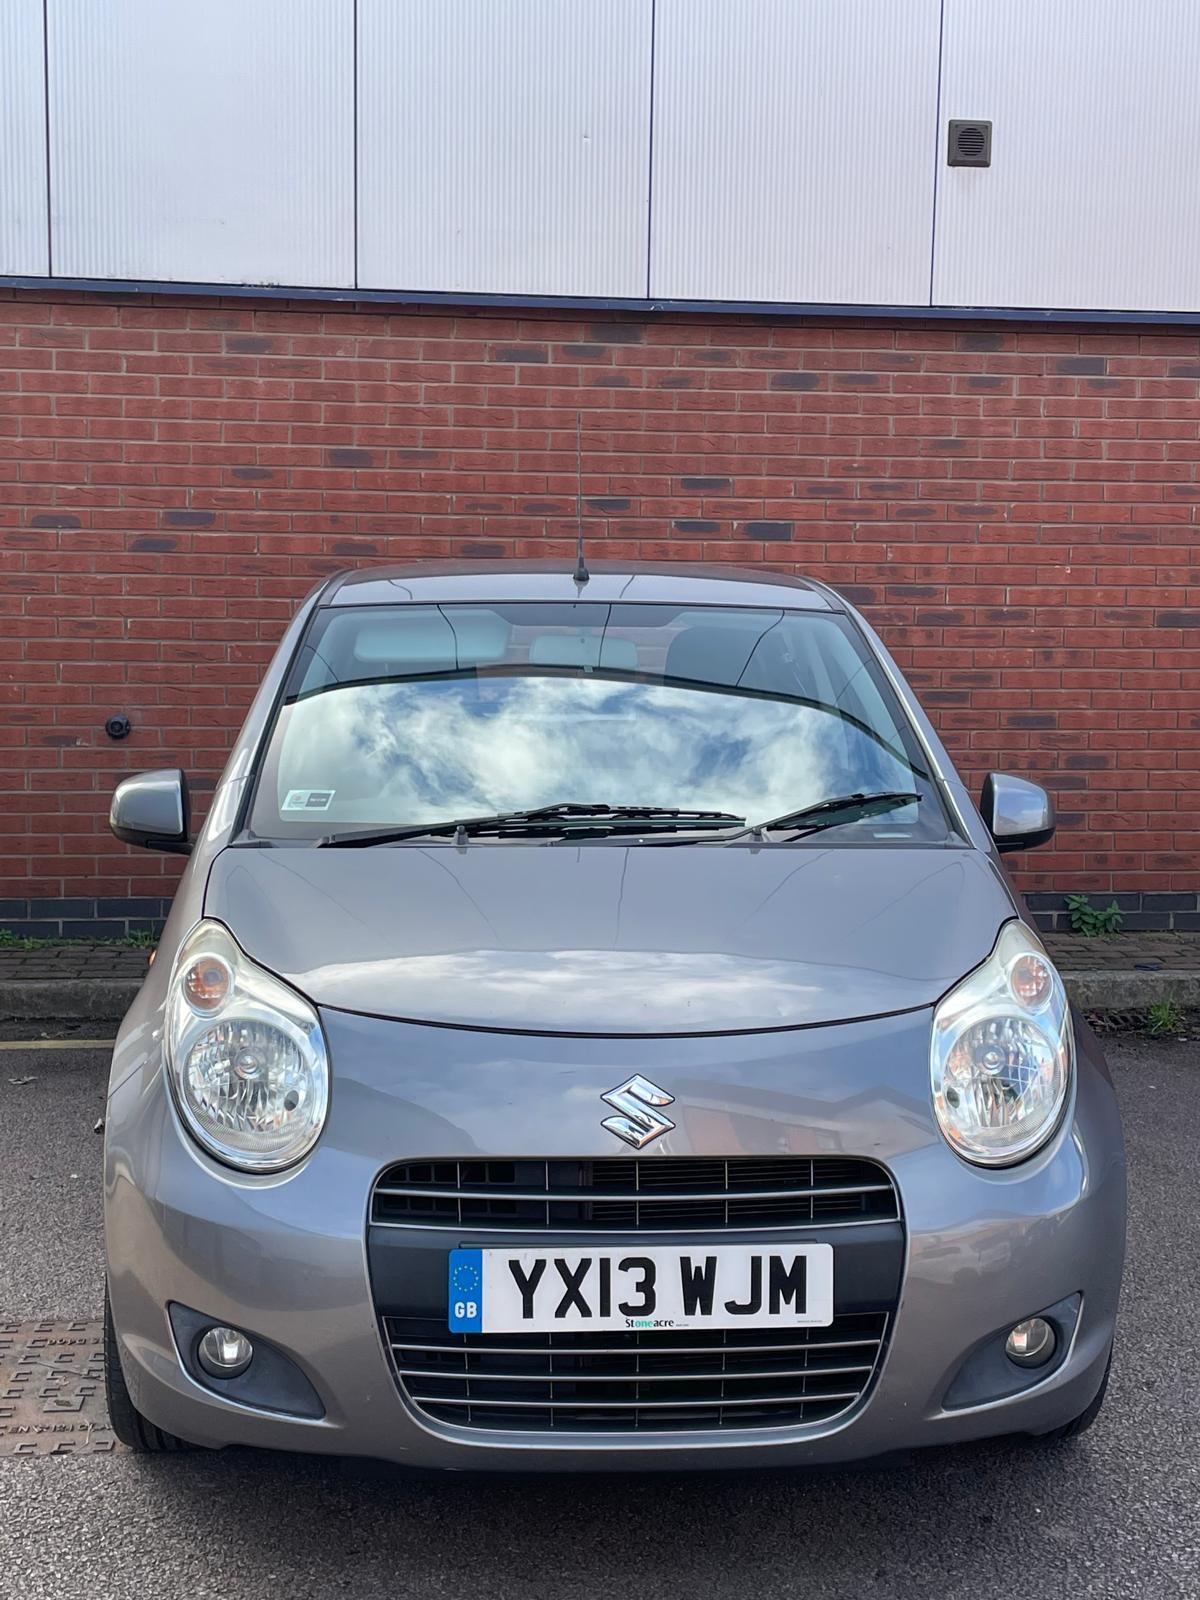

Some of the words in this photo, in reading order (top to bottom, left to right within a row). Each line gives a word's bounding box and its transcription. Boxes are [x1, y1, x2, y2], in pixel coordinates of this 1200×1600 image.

[507, 1256, 656, 1319] YX13
[679, 1255, 807, 1316] WJM
[454, 1301, 477, 1318] GB
[625, 1318, 674, 1328] Stoneacre
